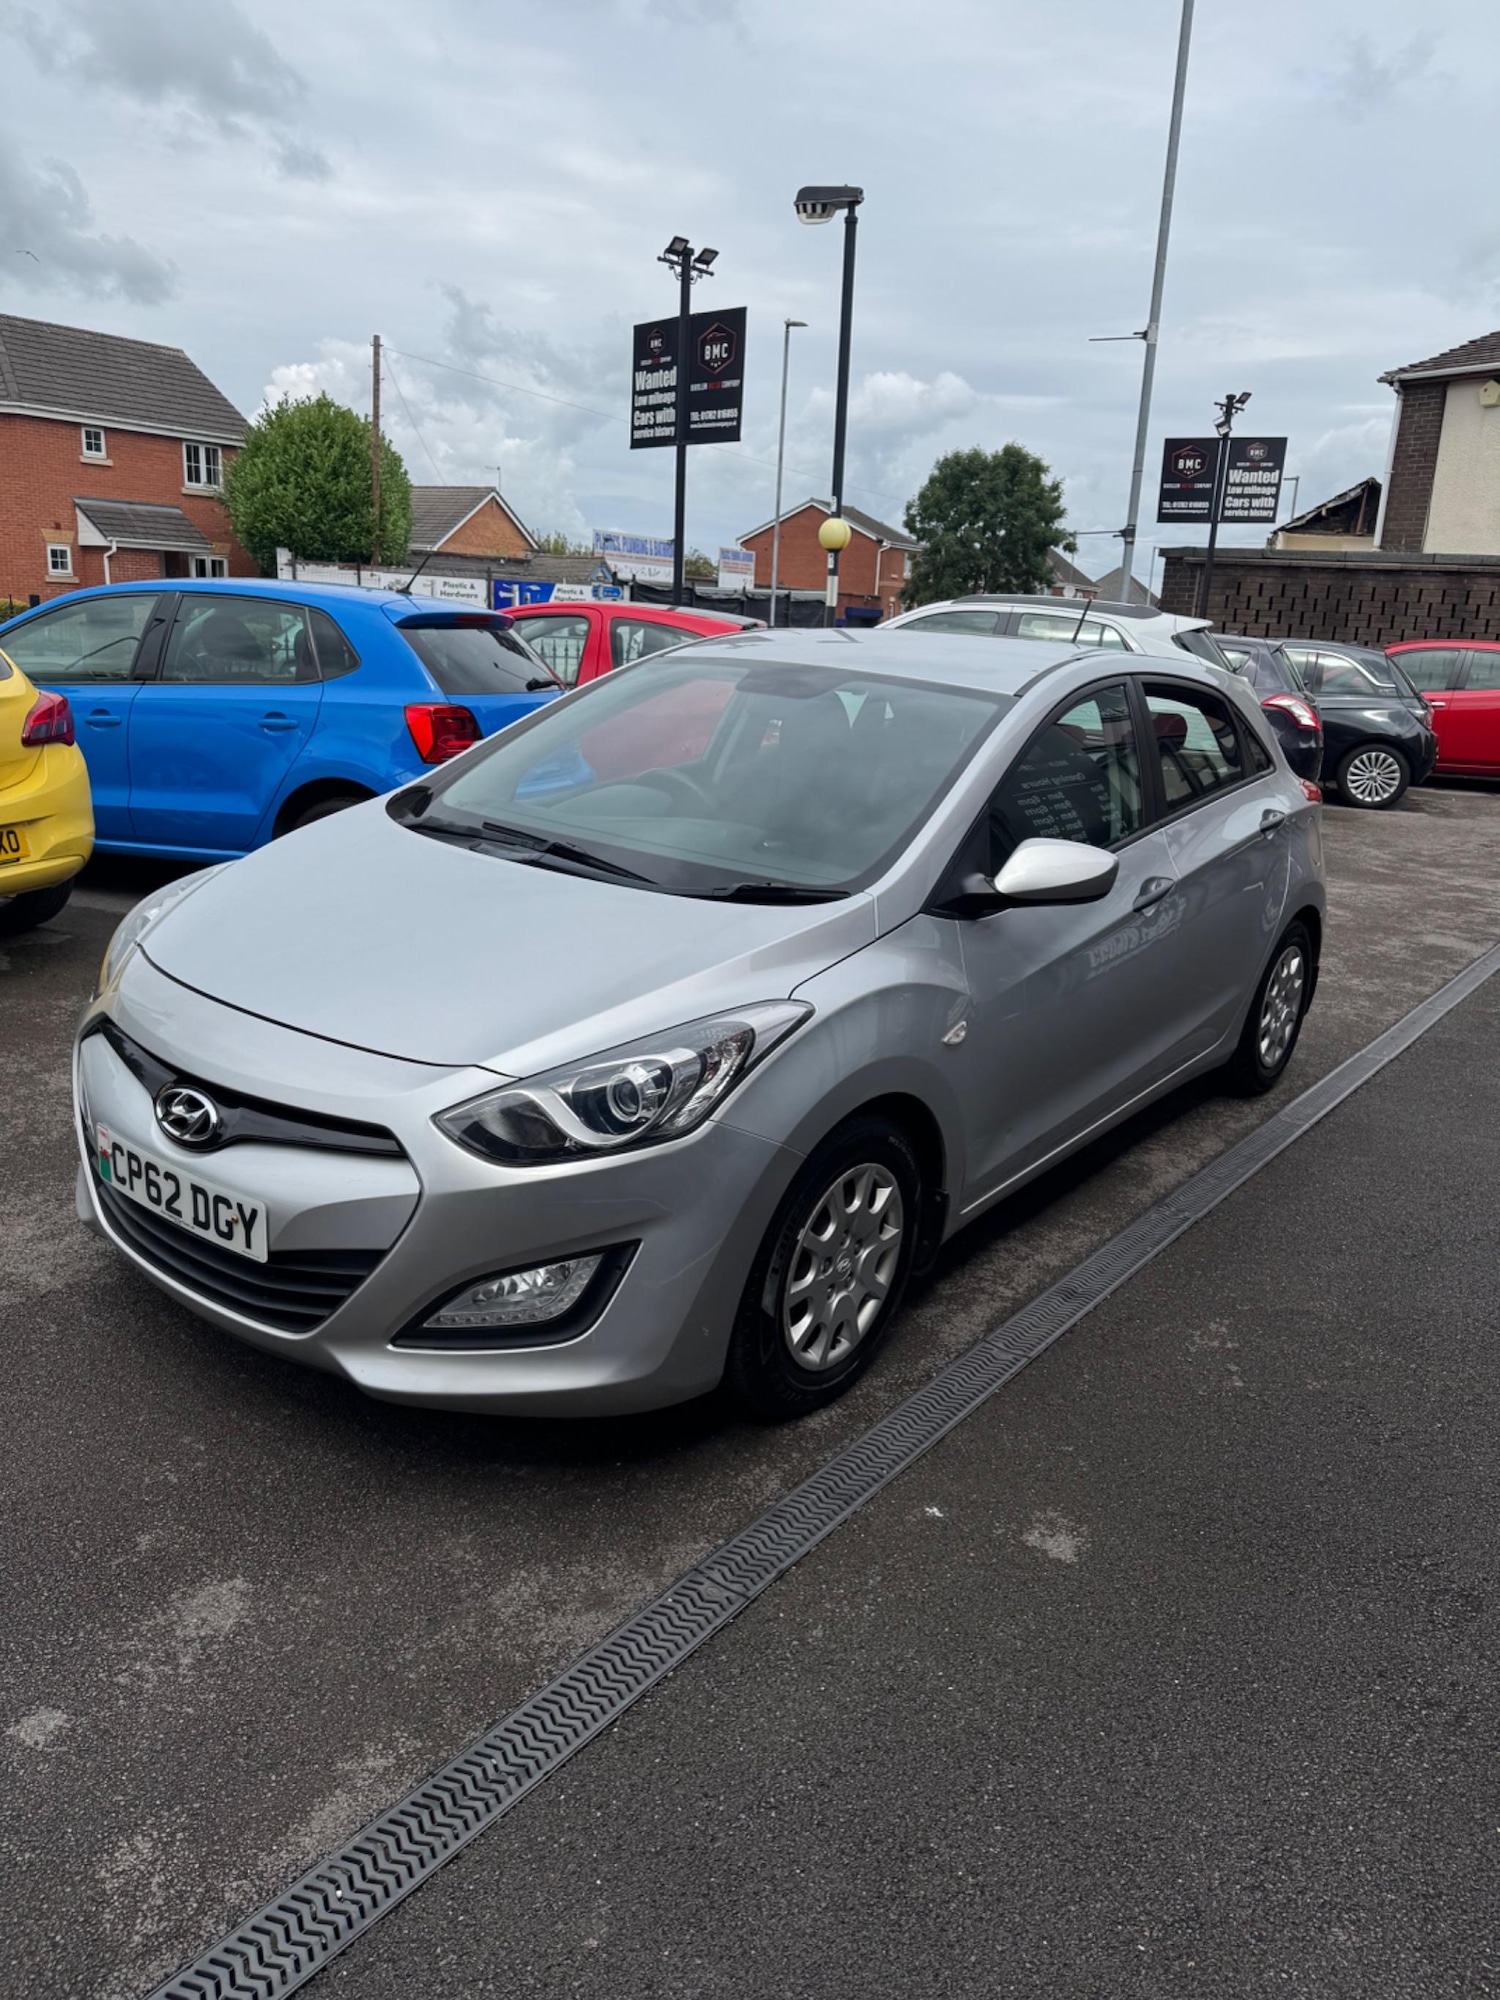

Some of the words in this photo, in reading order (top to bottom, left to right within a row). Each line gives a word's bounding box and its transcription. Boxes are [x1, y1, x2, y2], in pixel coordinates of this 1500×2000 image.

[704, 343, 729, 360] BMC
[635, 366, 677, 391] Wanted
[634, 394, 648, 407] Low
[648, 391, 676, 405] mileage
[633, 410, 655, 426] Cars
[655, 406, 676, 424] with
[633, 428, 654, 439] service
[654, 426, 676, 437] history
[1178, 459, 1202, 469] BMC
[1229, 469, 1280, 484] Wanted
[1227, 485, 1243, 494] Low
[1243, 485, 1277, 495] mileage
[1225, 497, 1250, 508] Cars
[1251, 496, 1275, 508] with
[1249, 509, 1274, 517] history
[443, 581, 467, 589] Plastic
[469, 582, 476, 590] &
[440, 589, 479, 599] Hardware
[111, 1142, 182, 1218] CP62
[190, 1182, 258, 1249] DGY
